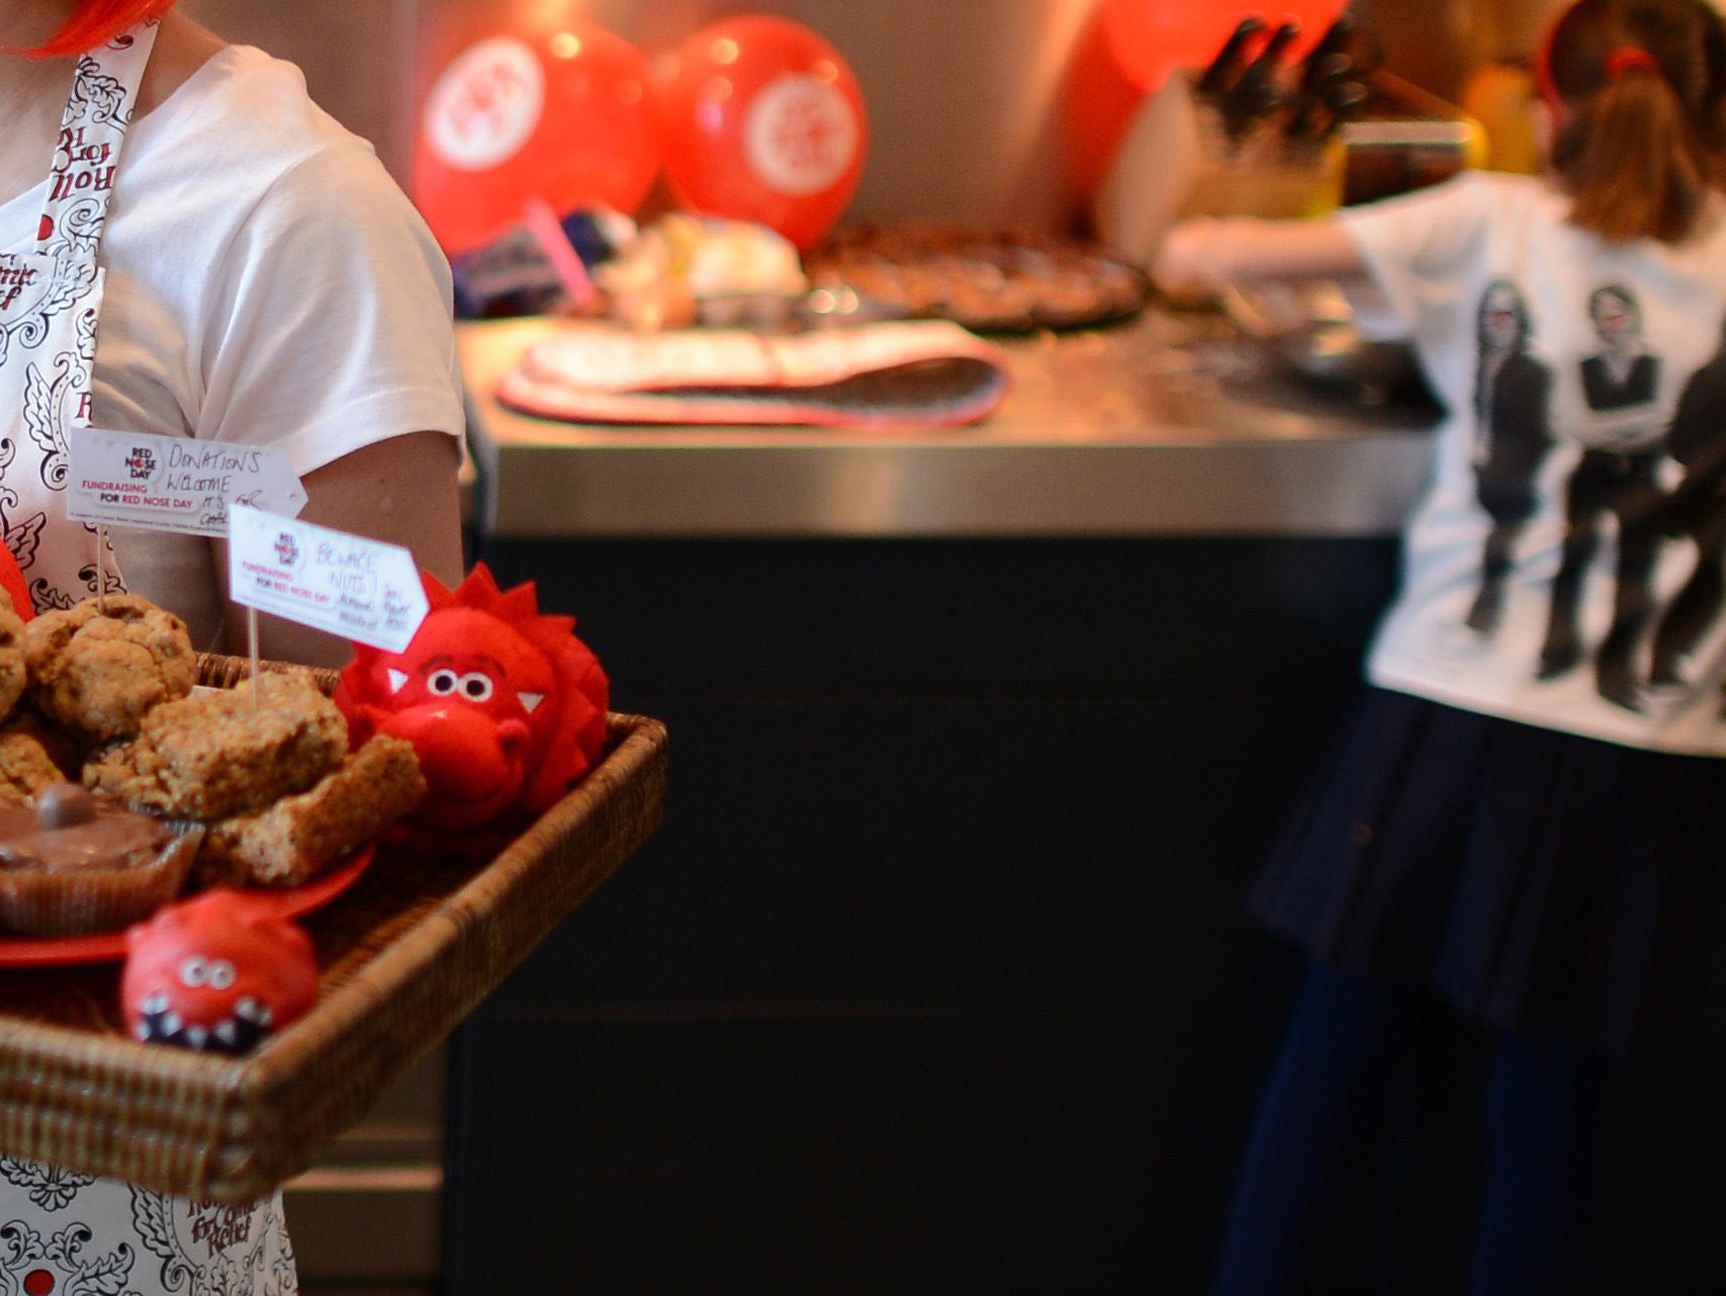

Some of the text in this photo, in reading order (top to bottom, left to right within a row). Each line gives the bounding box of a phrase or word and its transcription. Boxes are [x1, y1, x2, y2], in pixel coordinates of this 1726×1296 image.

[132, 447, 152, 459] RED
[168, 443, 262, 474] DONATIONS
[125, 458, 157, 471] NOSE
[130, 469, 151, 480] DAY
[82, 480, 148, 494] FUNDRAISING
[100, 493, 193, 509] FOR RED NOSE DAY
